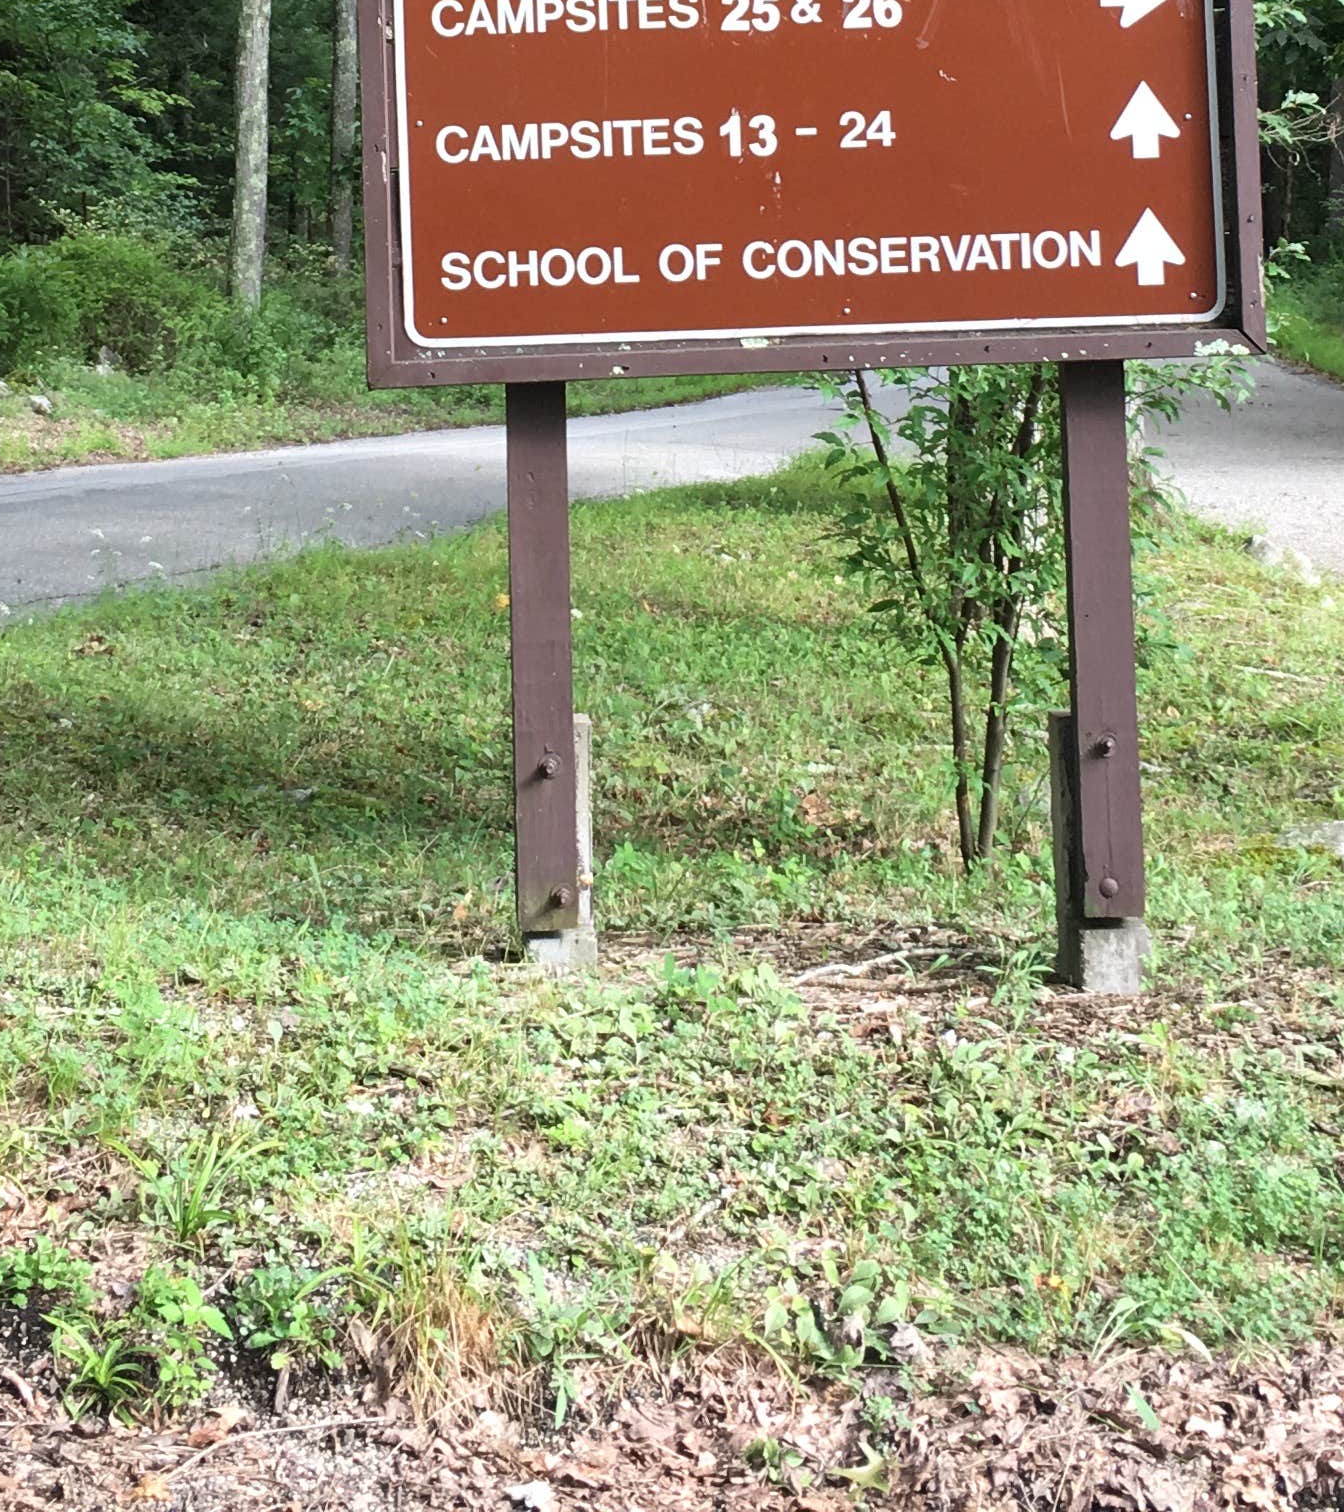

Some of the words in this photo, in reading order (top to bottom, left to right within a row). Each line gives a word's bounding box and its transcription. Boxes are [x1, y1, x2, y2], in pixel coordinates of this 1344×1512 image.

[434, 116, 705, 164] CAMPSITES
[718, 113, 778, 157] 13
[839, 110, 897, 149] 24
[439, 245, 641, 291] SCHOOL
[658, 243, 723, 282] OF
[741, 229, 1102, 280] CONSERVATION
